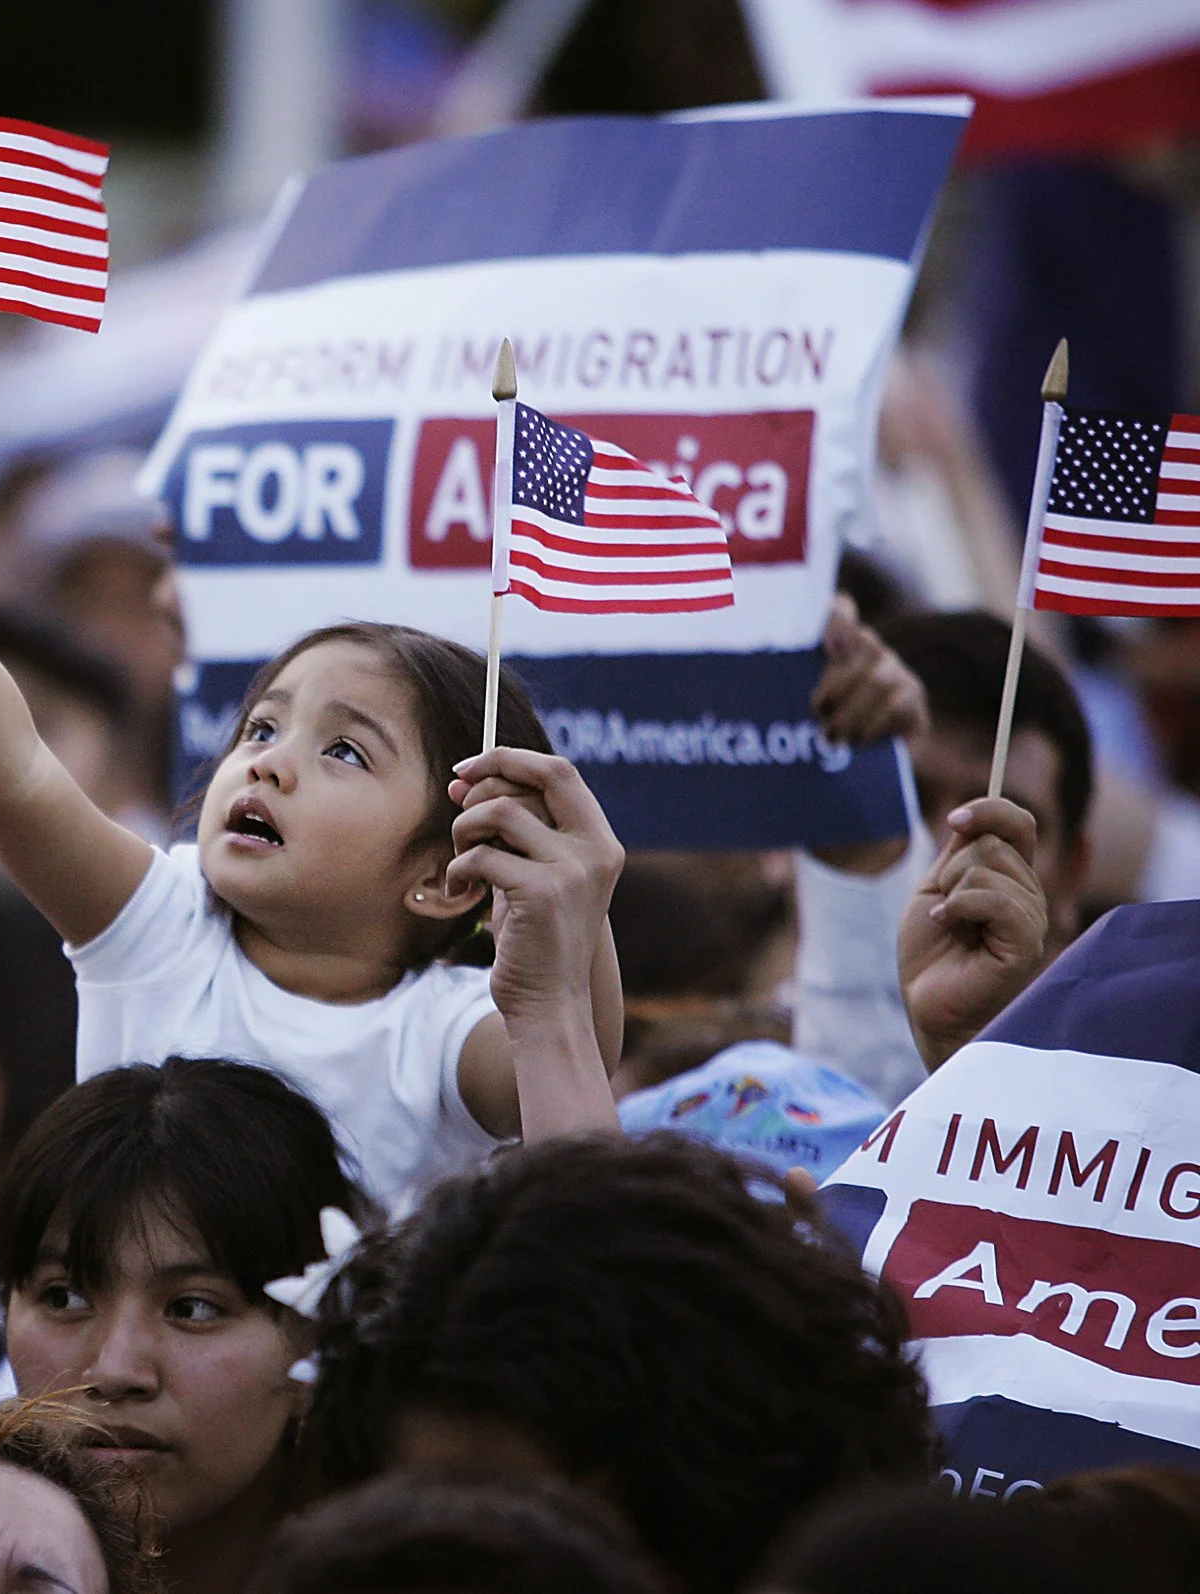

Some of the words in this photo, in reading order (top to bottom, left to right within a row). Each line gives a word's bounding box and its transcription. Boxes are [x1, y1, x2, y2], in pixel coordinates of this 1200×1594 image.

[428, 327, 836, 393] IMMIGRATION
[183, 440, 365, 543] FOR
[912, 1240, 1200, 1359] Ame
